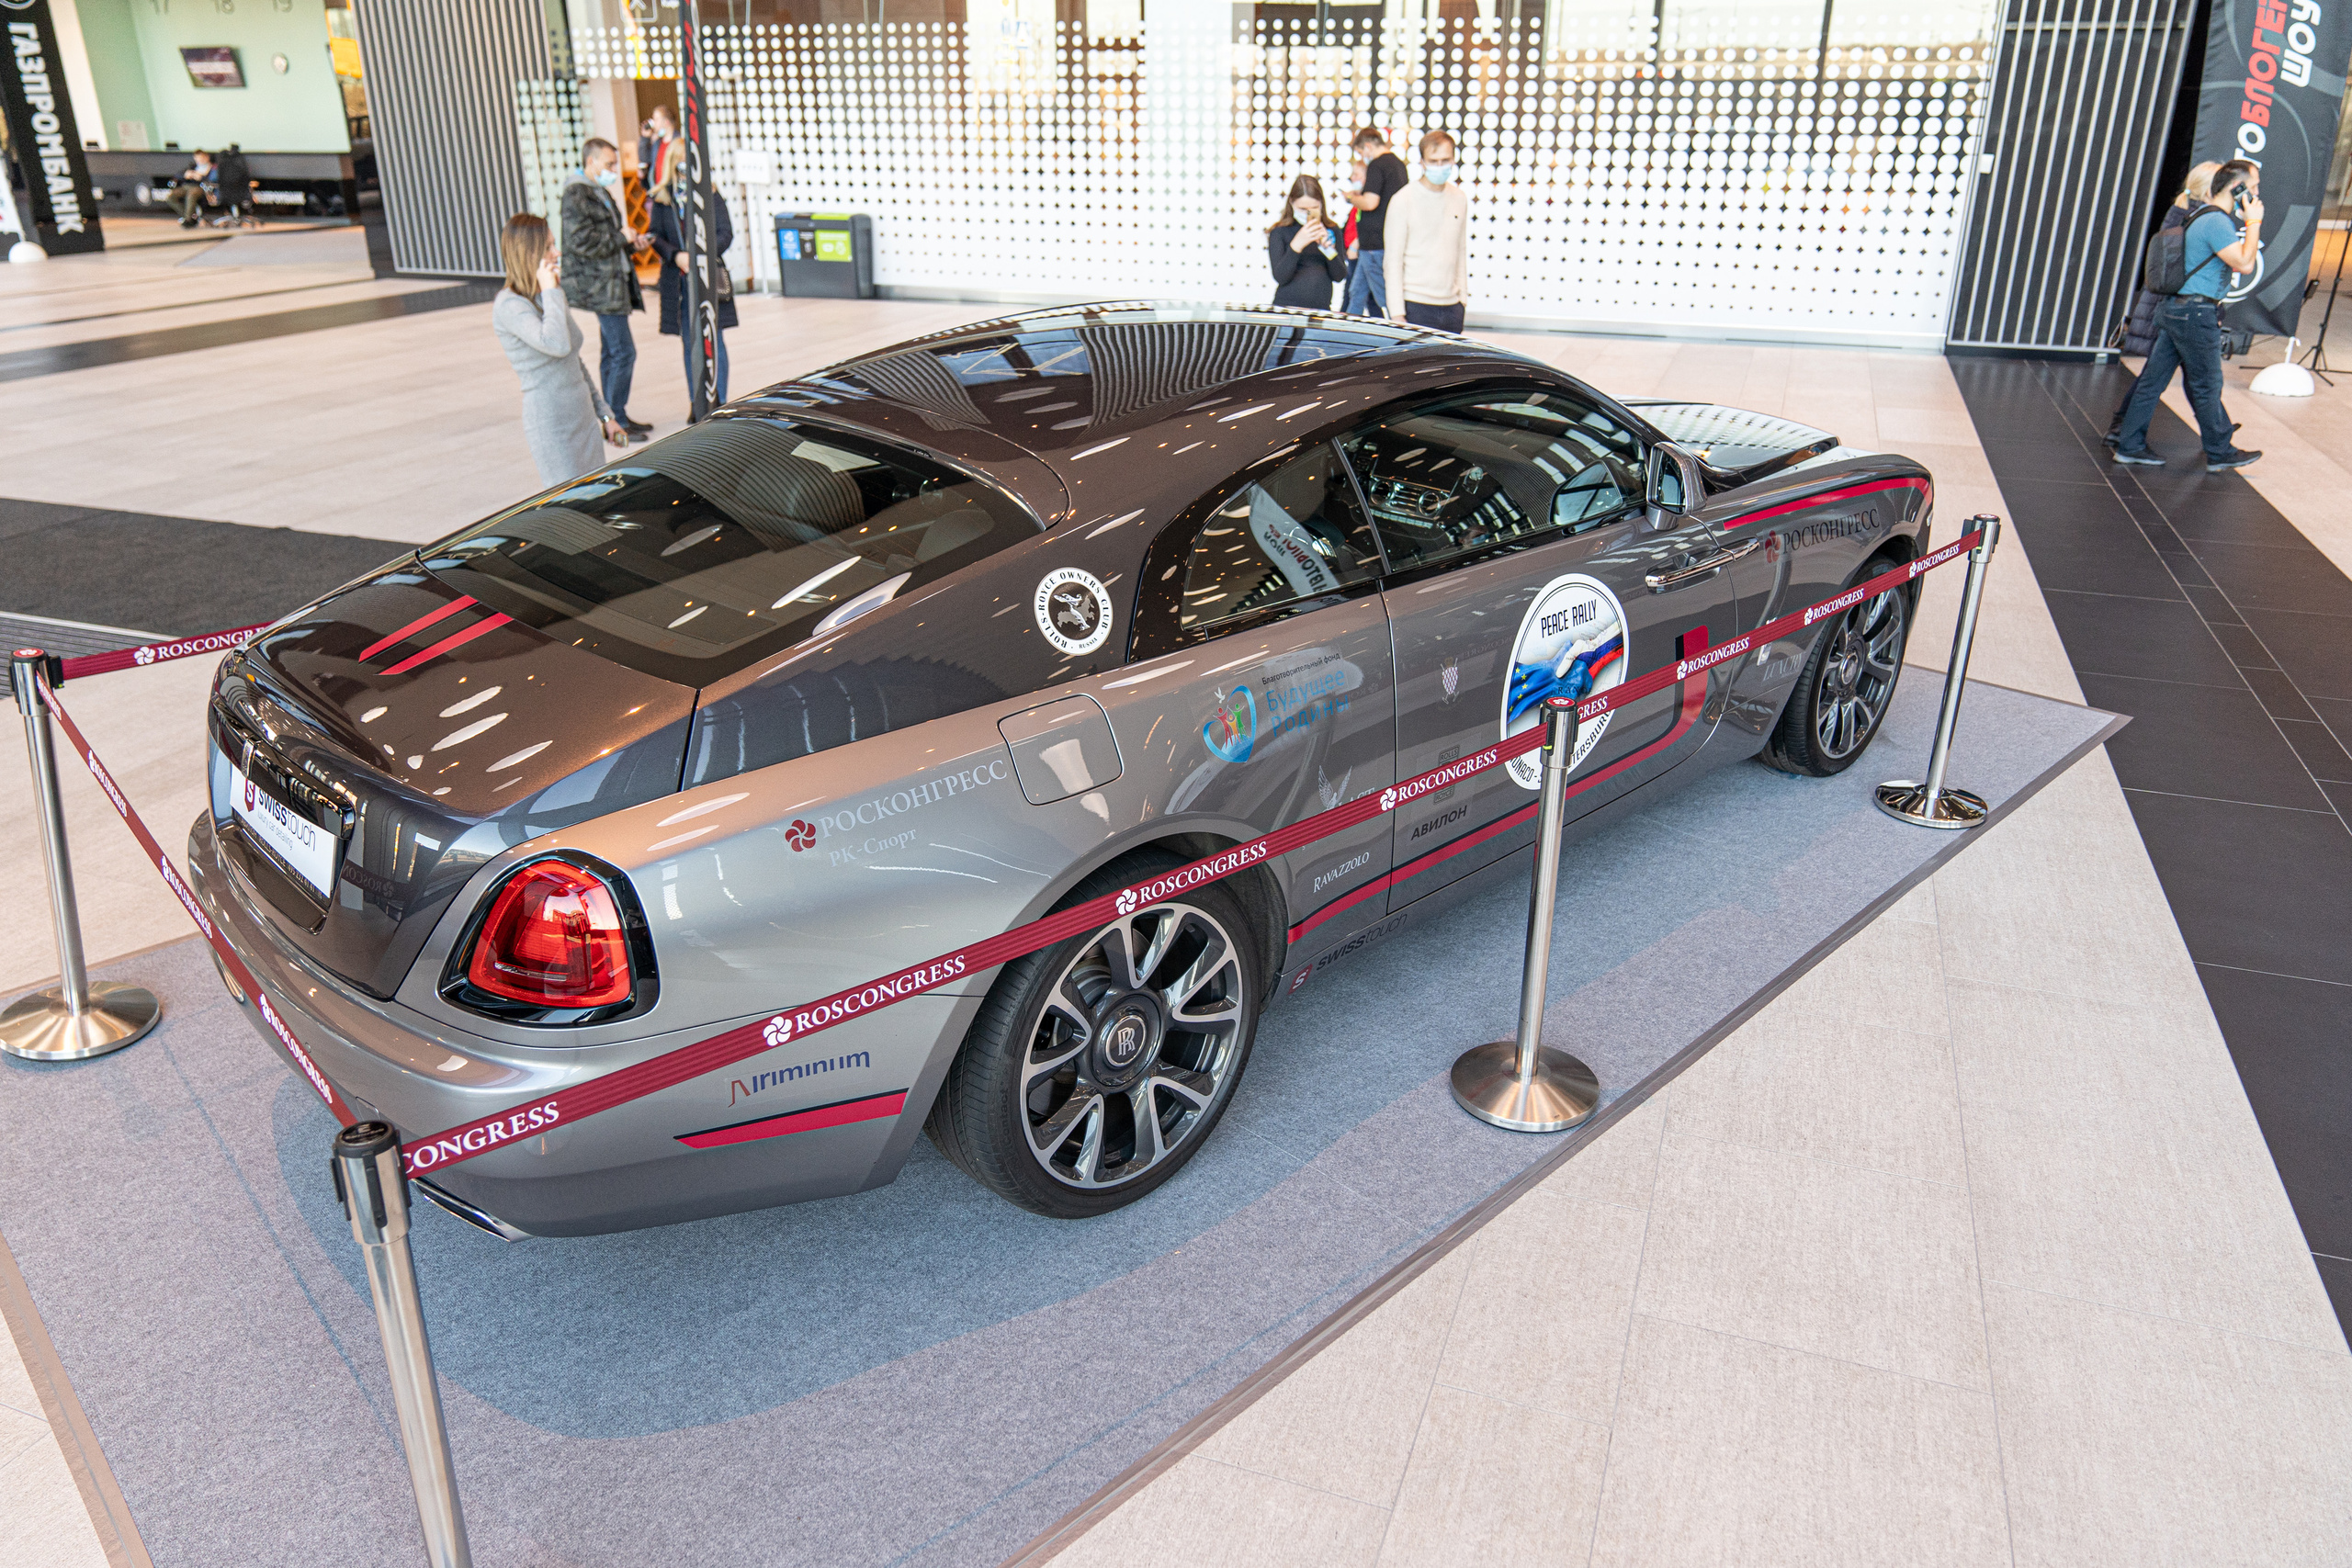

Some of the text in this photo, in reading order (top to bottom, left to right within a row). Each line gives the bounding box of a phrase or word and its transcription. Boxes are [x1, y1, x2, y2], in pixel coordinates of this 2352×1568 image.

[2280, 0, 2323, 87] ШОУ
[7, 21, 85, 235] ГАЗПРОМБАНК
[1782, 508, 1880, 554] РОСКОНГРЕСС
[1916, 543, 1961, 573] ROSCONGRESS
[1038, 570, 1110, 649] ROLLS-ROYCE OWNERS CLUB
[1540, 599, 1597, 638] PEACE RALLY
[1813, 588, 1864, 619] ROSCONGRESS
[1079, 637, 1098, 649] RUSSIA
[1687, 637, 1750, 672] ROSCONGRESS
[1261, 652, 1341, 685] Благотворительный фонд
[1266, 670, 1345, 713] Будущее
[1271, 694, 1350, 738] Родины
[1397, 749, 1498, 802] ROSCONGRESS
[1440, 749, 1459, 761] ROLLS
[818, 760, 1008, 839] РОСКОНГРЕСС
[1410, 805, 1468, 841] АВИЛОН
[1138, 840, 1268, 905] ROSCONGRESS
[165, 865, 213, 940] ROSCONGRESS
[795, 954, 966, 1033] ROSCONGRESS
[266, 1005, 334, 1104] ROSCONGRESS
[404, 1101, 560, 1175] CONGRESS
